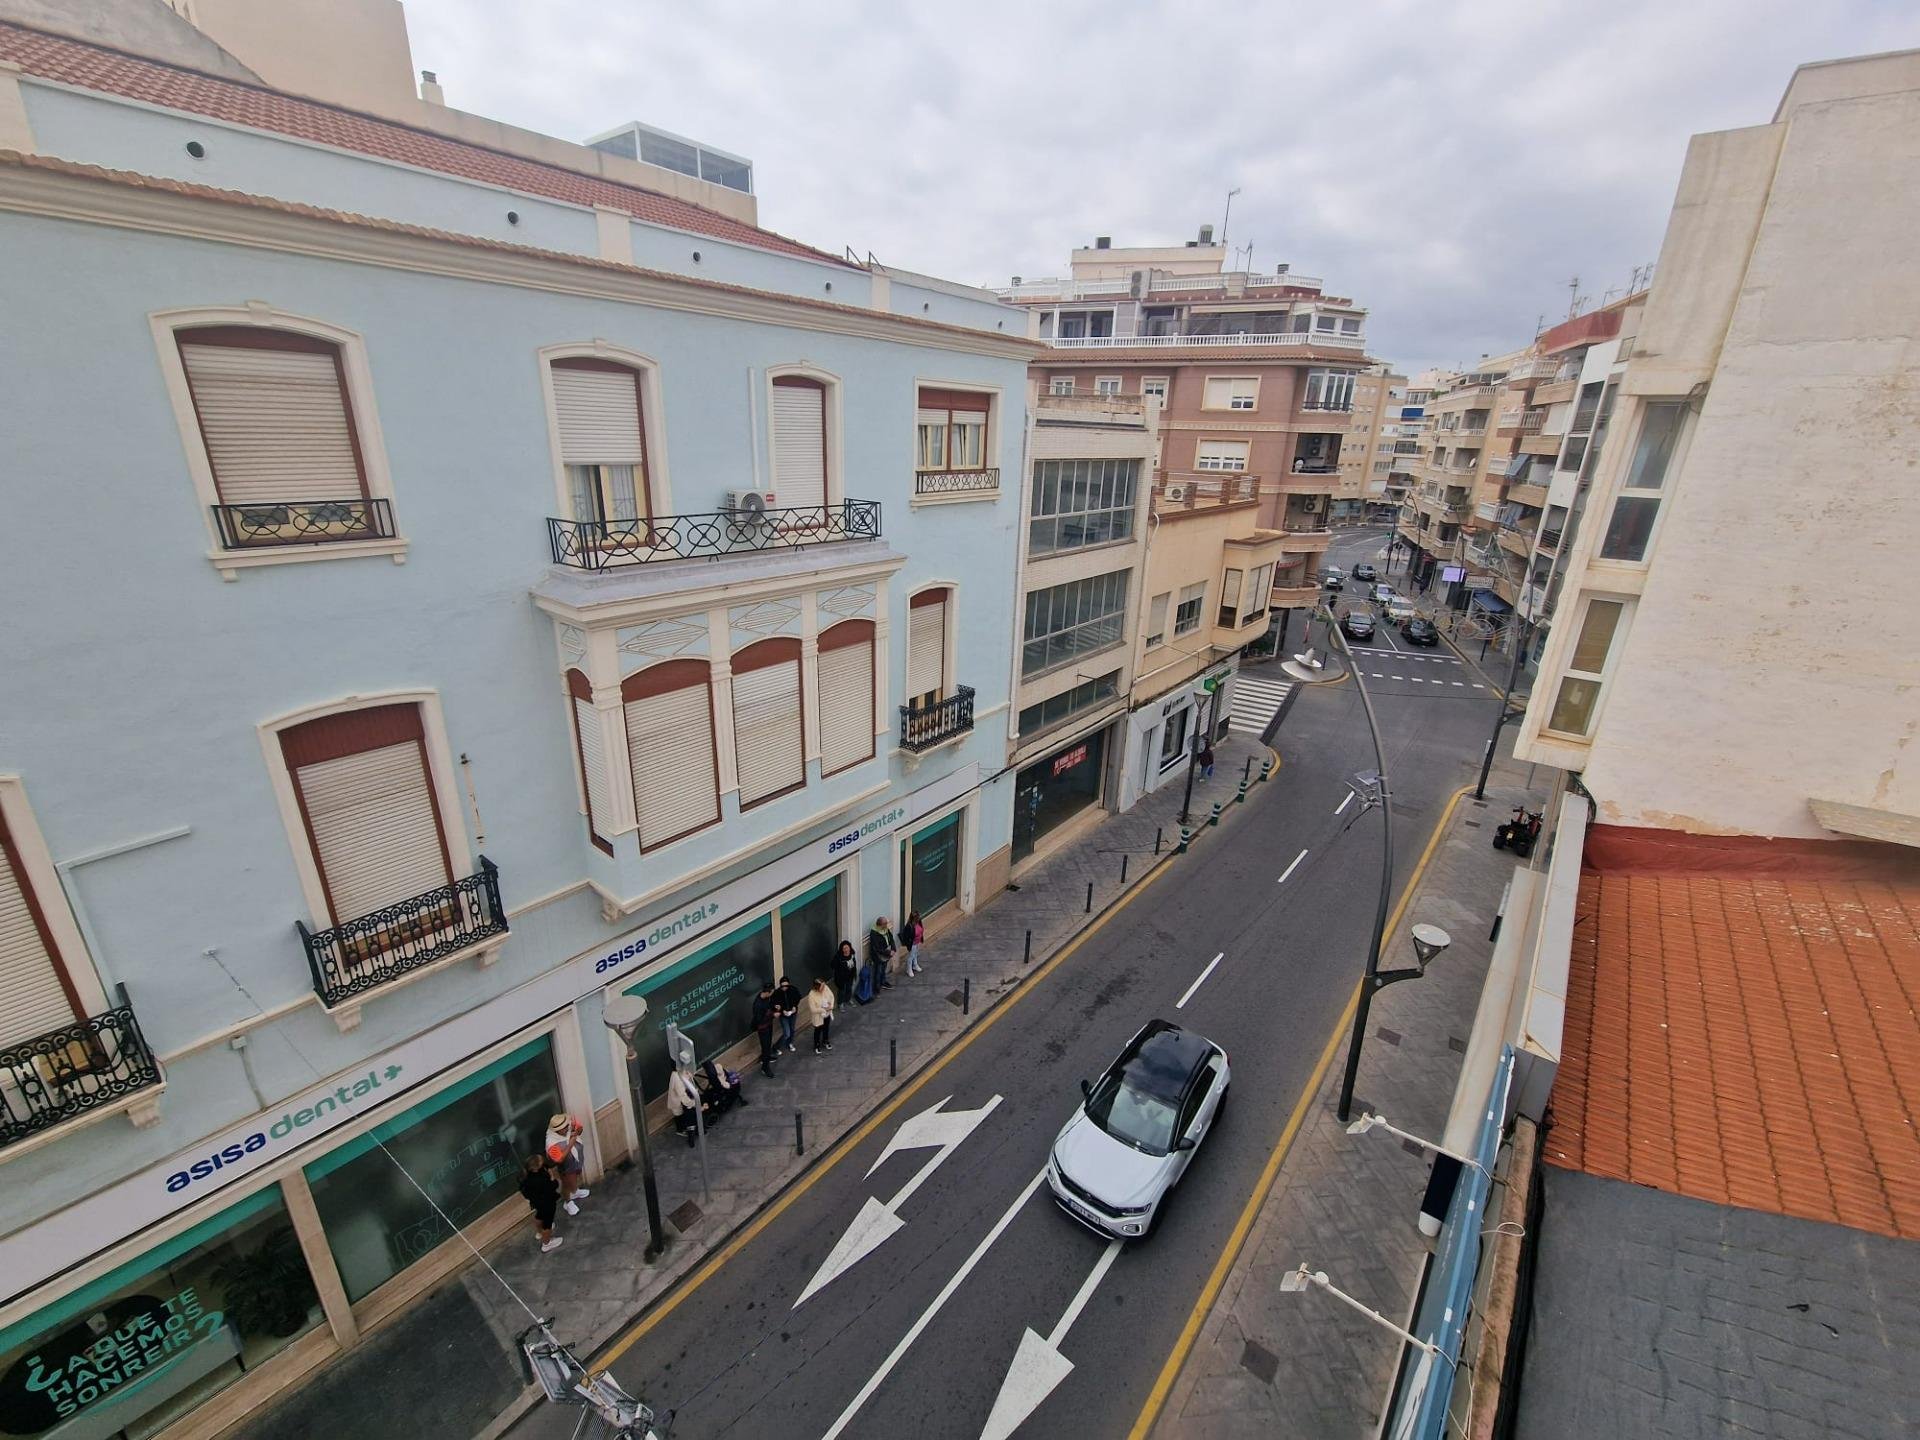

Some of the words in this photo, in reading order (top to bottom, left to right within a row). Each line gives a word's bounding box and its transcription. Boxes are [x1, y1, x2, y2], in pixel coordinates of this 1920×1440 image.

[828, 830, 860, 854] asisa
[595, 939, 647, 974] asisa
[664, 1000, 679, 1013] TE
[680, 966, 738, 1006] ATENDEMOS
[690, 997, 707, 1012] SIN
[708, 973, 745, 1001] SEGURO
[166, 1132, 267, 1194] asisa
[95, 1311, 157, 1355] QUE
[160, 1287, 198, 1314] TE
[48, 1304, 205, 1402] HACEMOS
